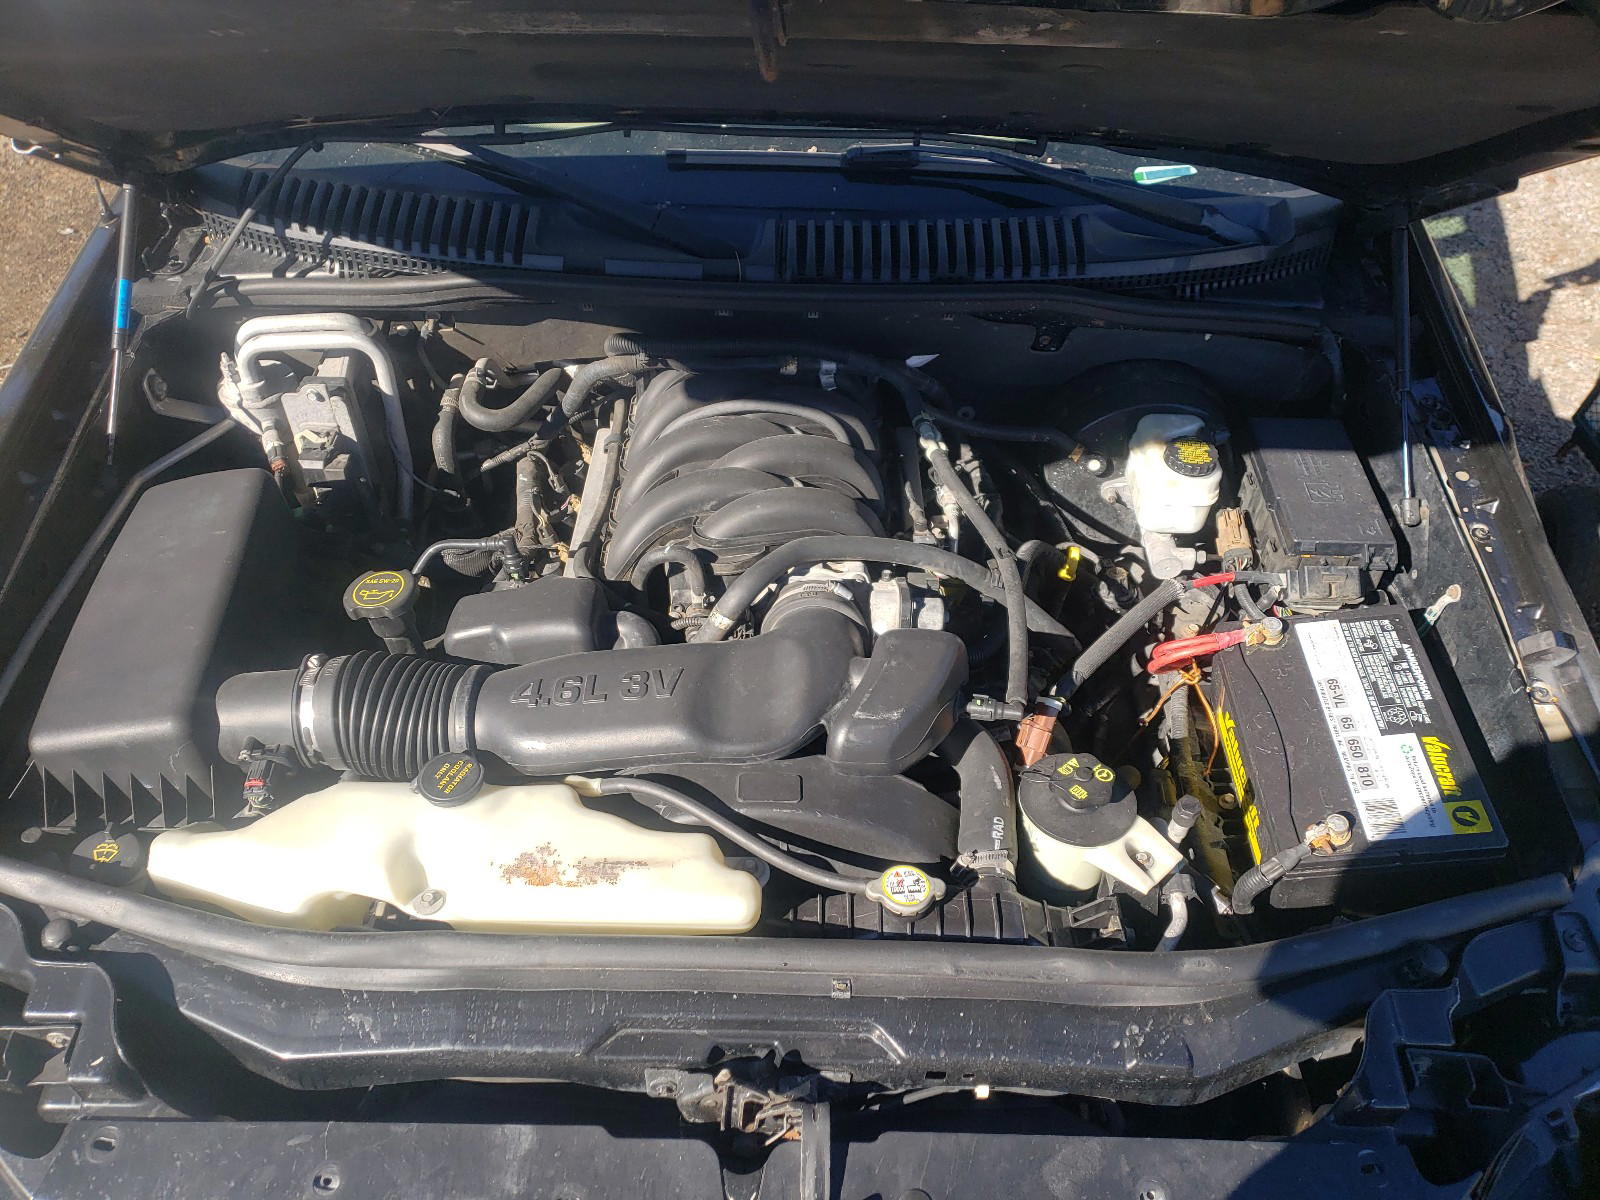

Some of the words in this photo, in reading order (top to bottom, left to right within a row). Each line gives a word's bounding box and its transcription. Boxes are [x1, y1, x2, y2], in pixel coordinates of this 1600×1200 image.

[511, 674, 608, 708] 4.6L
[619, 668, 685, 701] 3V
[1326, 678, 1346, 708] 65-VL
[1340, 716, 1353, 730] 65
[1347, 738, 1364, 759] 650
[1357, 765, 1374, 787] 810
[435, 763, 450, 779] ONLY
[437, 760, 464, 789] COOLANT
[444, 763, 473, 794] RADIATOR
[1421, 736, 1463, 797] Valucraft
[992, 816, 1005, 840] RAD
